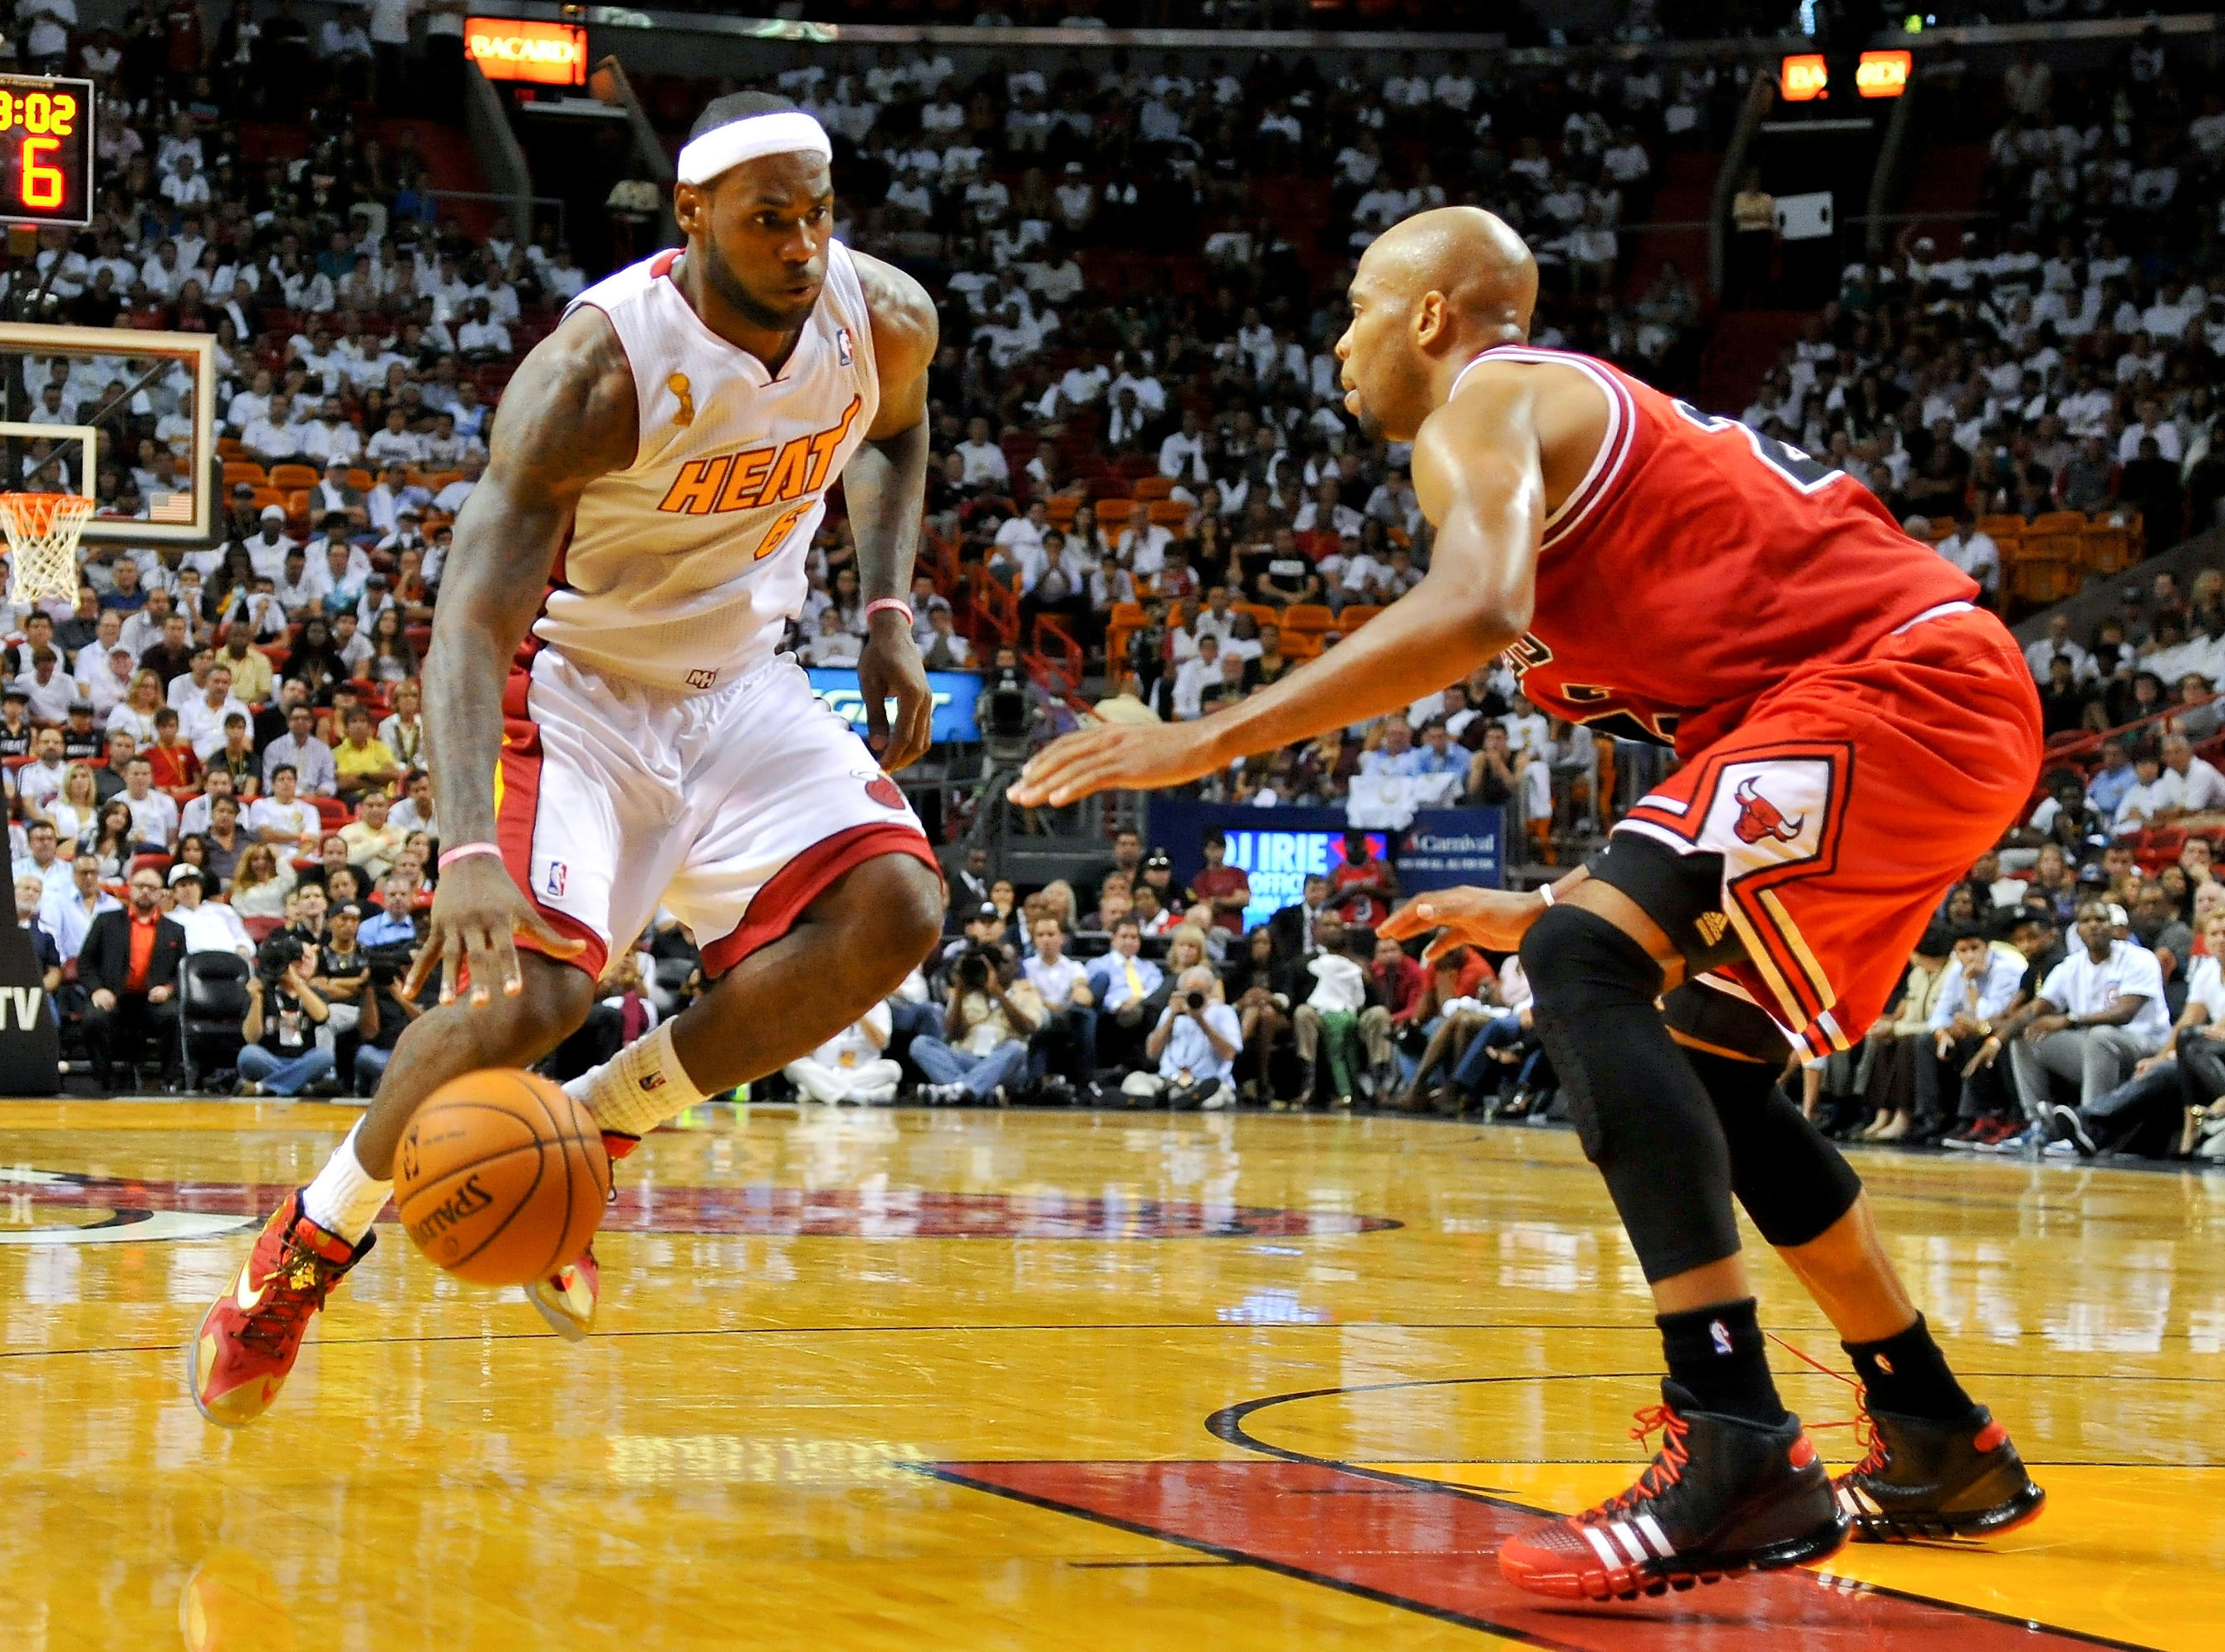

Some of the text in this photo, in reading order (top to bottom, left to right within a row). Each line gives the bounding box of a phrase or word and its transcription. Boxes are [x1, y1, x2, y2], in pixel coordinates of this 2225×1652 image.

[470, 34, 581, 64] BACARDI
[1788, 61, 1906, 90] BARDI
[22, 136, 63, 208] 6
[657, 393, 862, 515] HEAT
[754, 499, 817, 561] 6
[1257, 832, 1328, 874] IRIE
